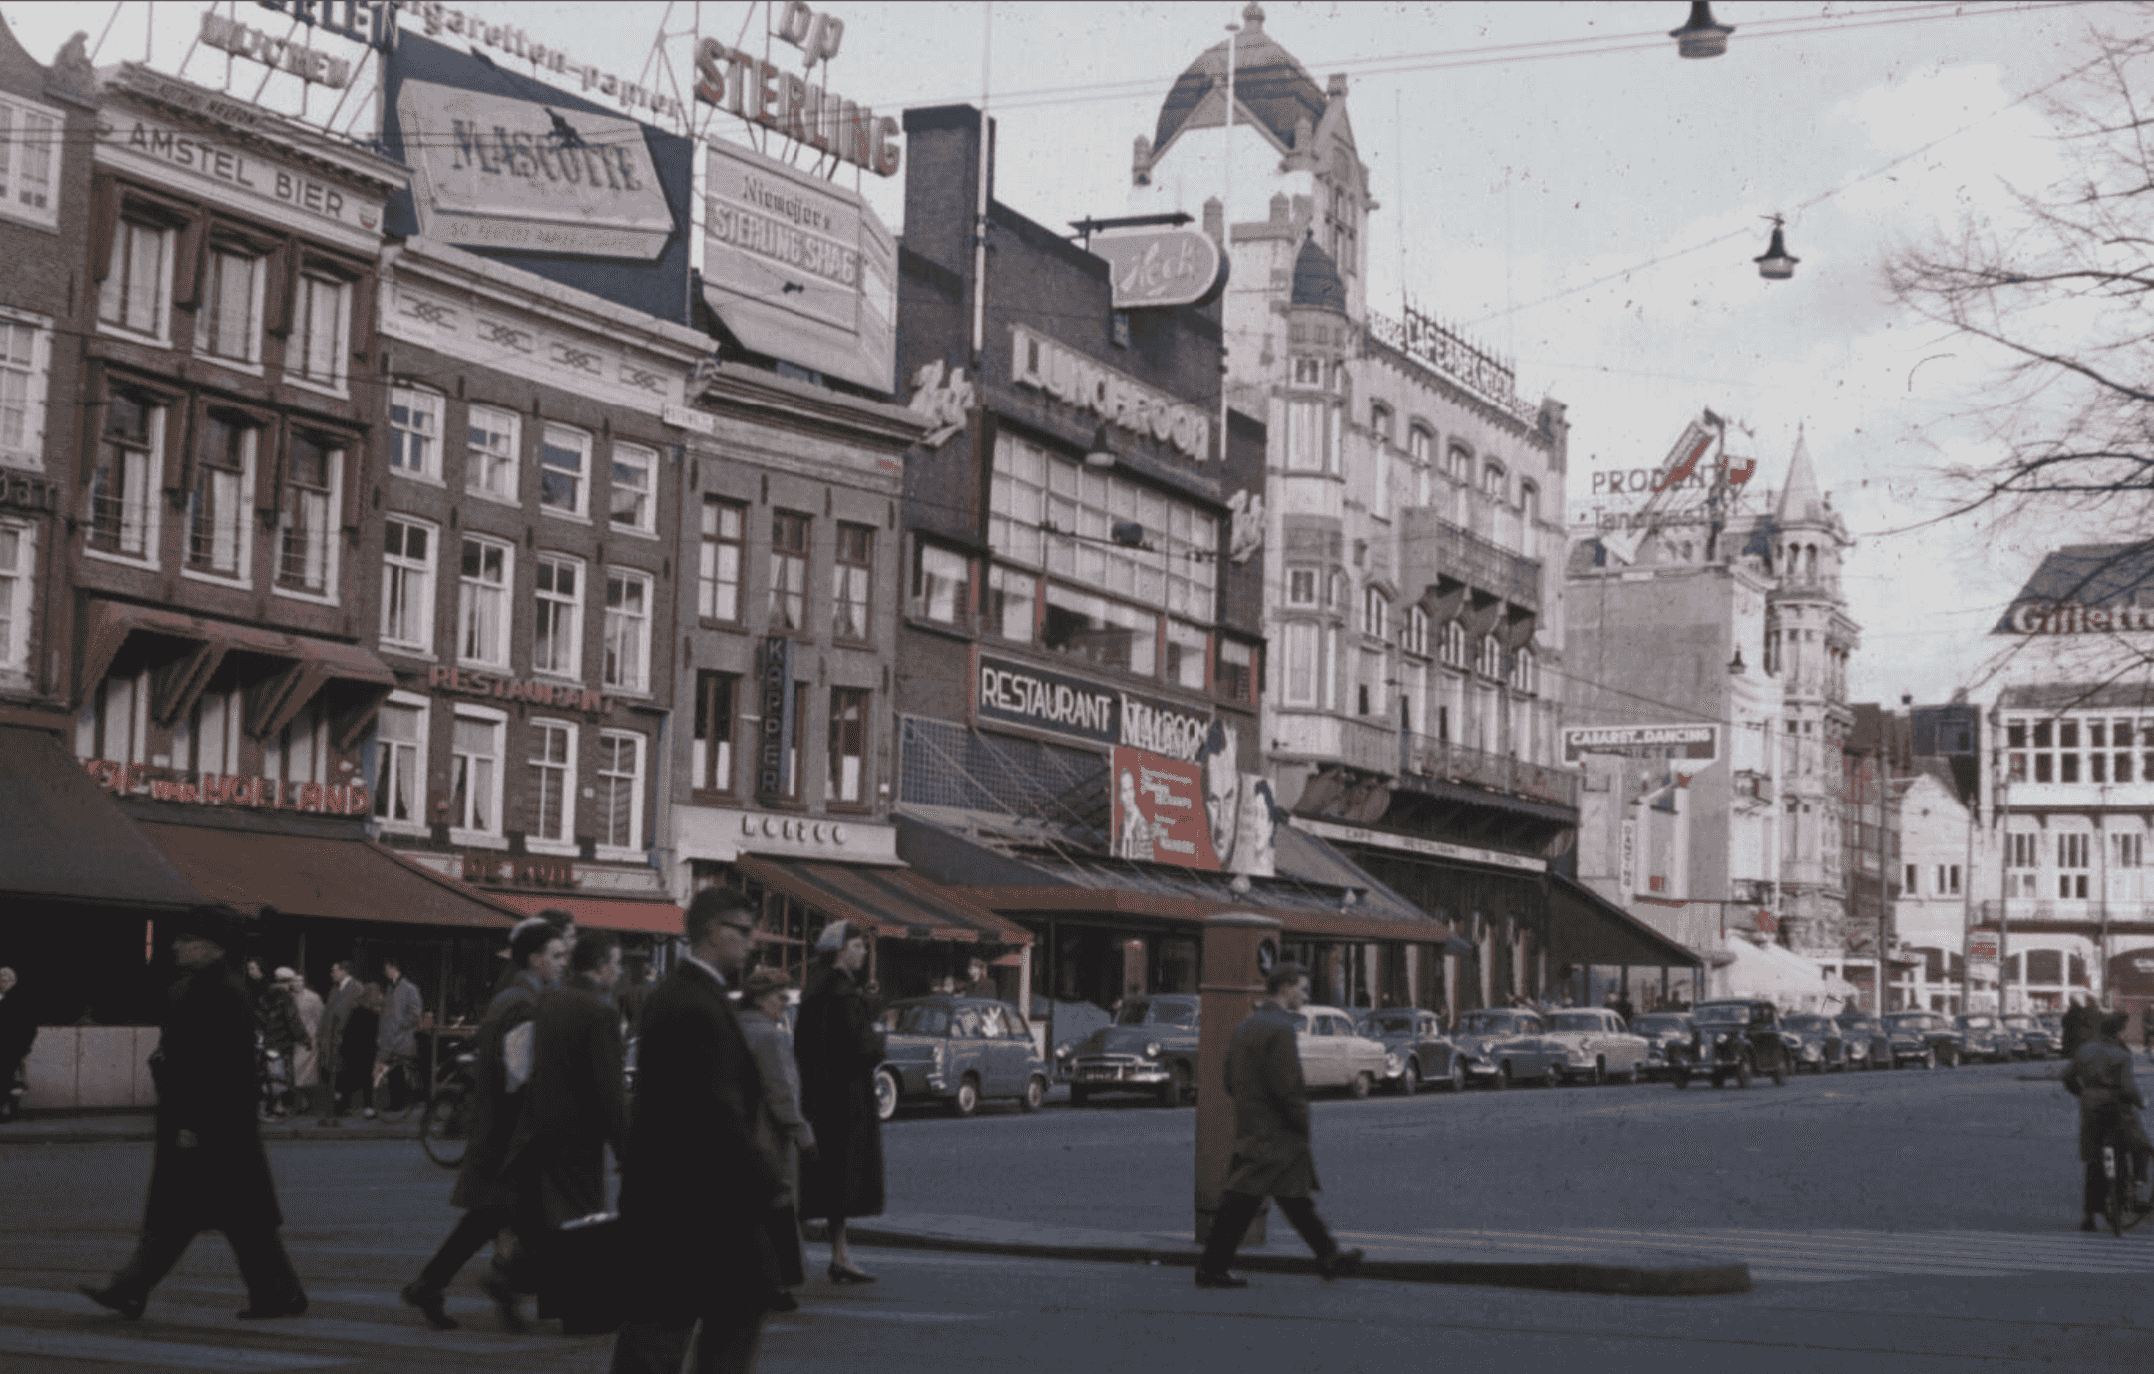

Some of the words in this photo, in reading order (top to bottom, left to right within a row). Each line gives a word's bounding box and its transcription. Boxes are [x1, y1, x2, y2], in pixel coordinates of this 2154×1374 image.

[693, 37, 900, 177] STERLING
[128, 121, 253, 187] AMSTEL
[275, 171, 344, 217] BIER
[451, 118, 641, 189] MASCOTTE
[713, 203, 802, 266] STERLING
[804, 235, 858, 284] SHAG
[1012, 328, 1209, 461] LUNCHROOM
[429, 665, 613, 713] RESTAURANT
[762, 638, 783, 791] KAPPER
[981, 666, 1112, 732] RESTAURANT
[199, 775, 370, 815] HOLLAND
